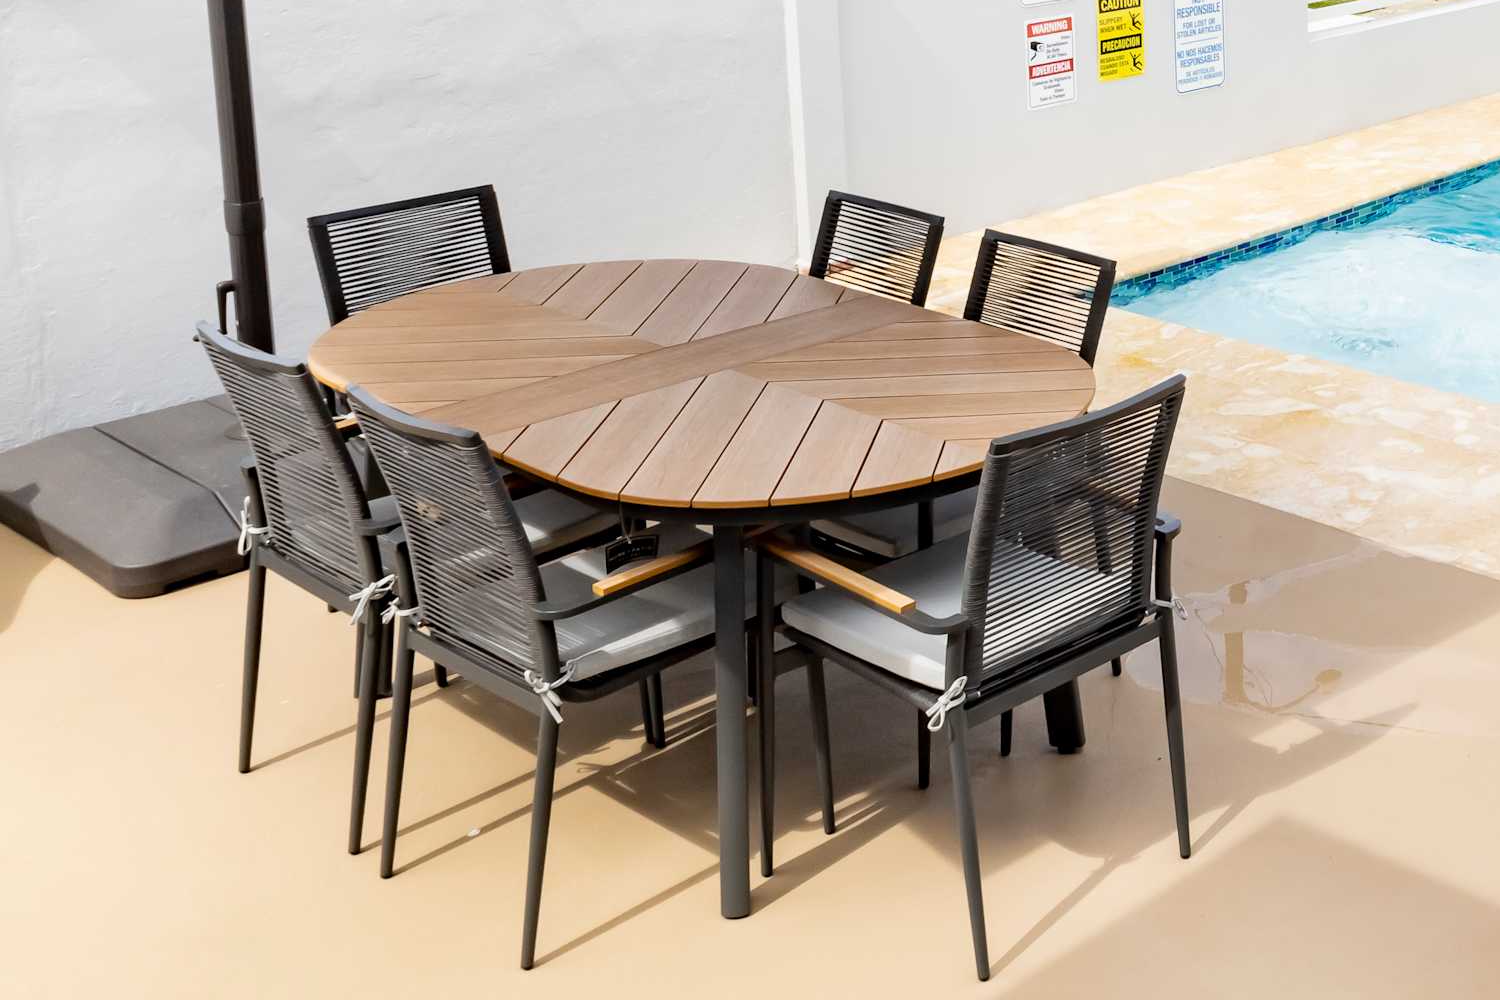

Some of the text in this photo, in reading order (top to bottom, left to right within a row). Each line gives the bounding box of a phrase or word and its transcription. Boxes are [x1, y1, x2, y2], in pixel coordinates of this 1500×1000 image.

[1176, 1, 1221, 19] RESPONSIBLE
[1031, 20, 1068, 35] WARNING
[1183, 17, 1216, 29] FOR LOST OR
[1176, 24, 1222, 40] STOLEN ARTICLES
[1176, 42, 1223, 59] NO NOS HACEMOS
[1180, 52, 1220, 68] RESPONSABLES
